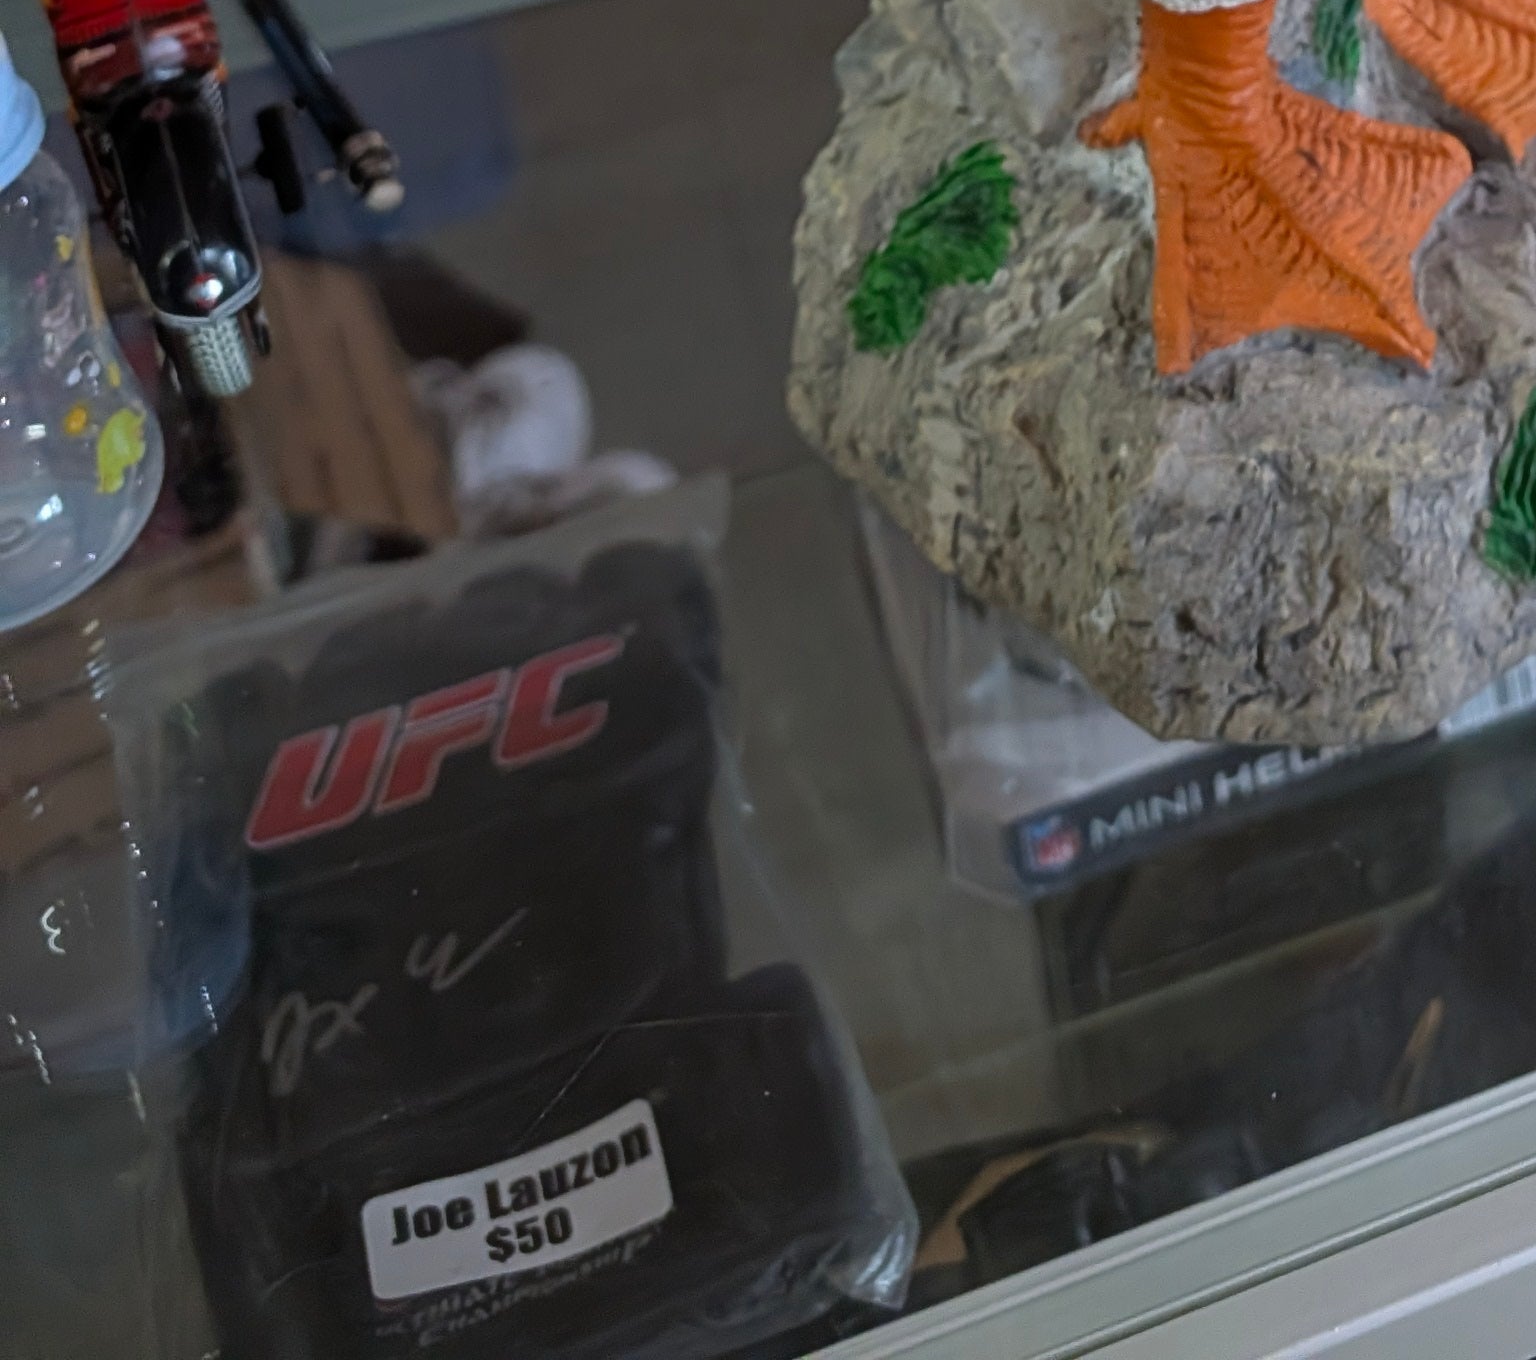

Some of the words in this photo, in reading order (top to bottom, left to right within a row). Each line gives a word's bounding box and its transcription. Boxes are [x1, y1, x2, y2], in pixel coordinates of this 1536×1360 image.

[245, 633, 626, 849] UFC
[1088, 781, 1203, 850] MINI
[1212, 744, 1364, 806] HEL
[390, 1196, 477, 1247] Joe
[484, 1122, 653, 1220] Lauzon
[485, 1206, 574, 1264] $50
